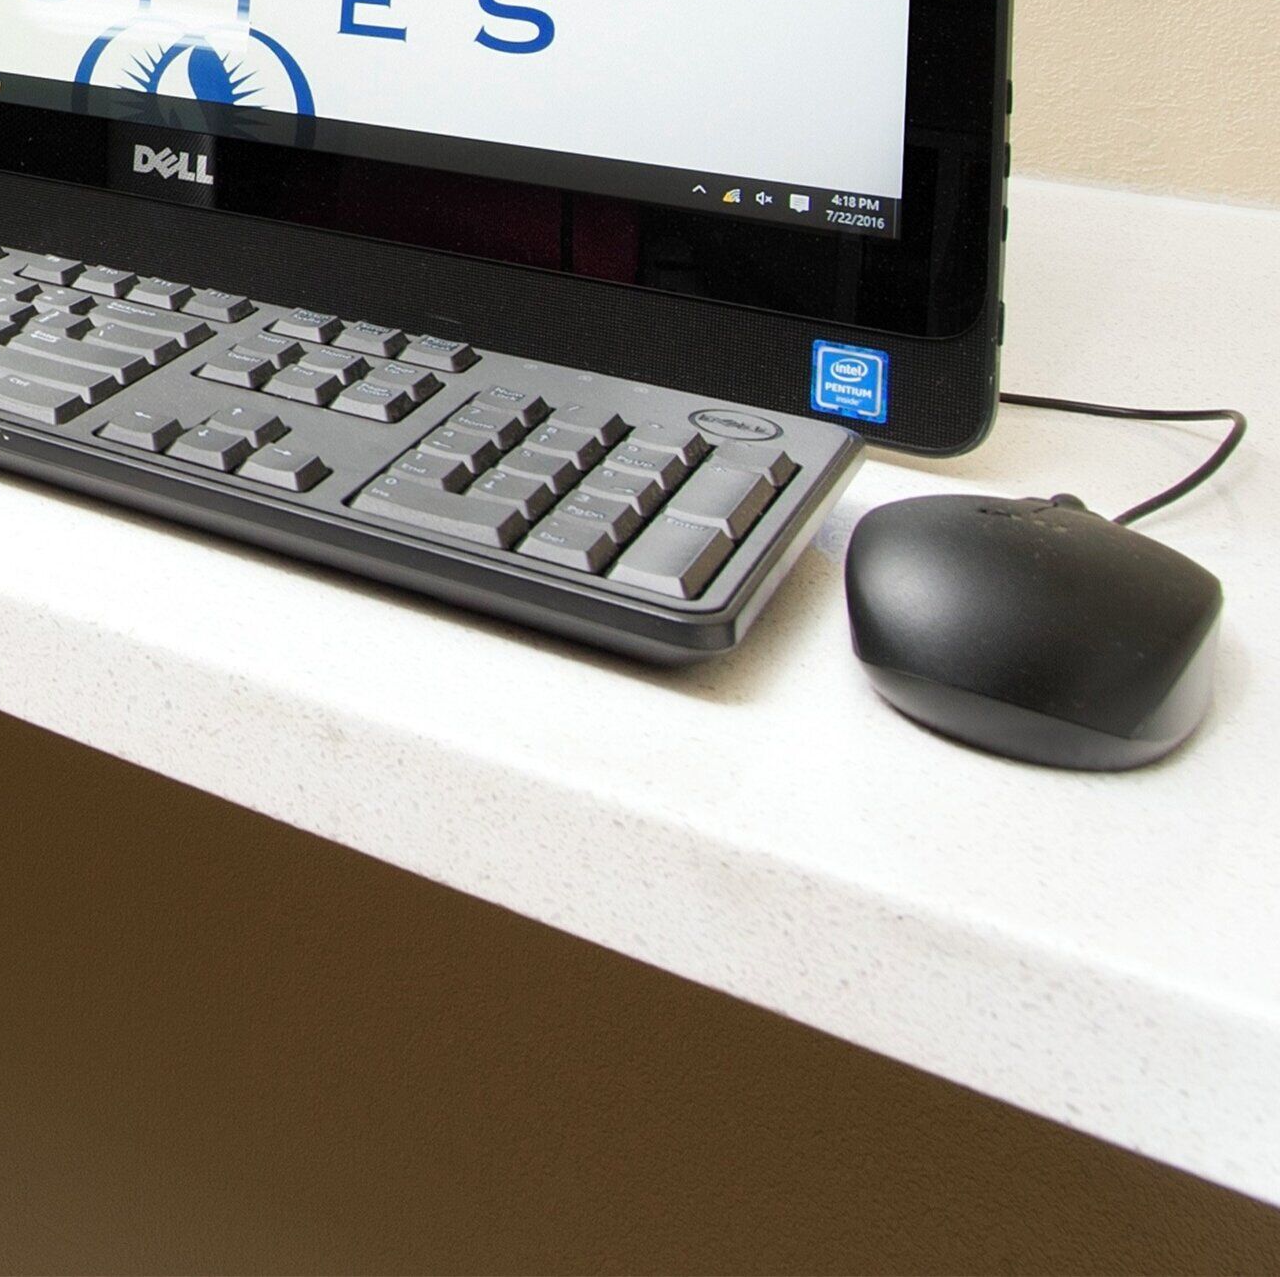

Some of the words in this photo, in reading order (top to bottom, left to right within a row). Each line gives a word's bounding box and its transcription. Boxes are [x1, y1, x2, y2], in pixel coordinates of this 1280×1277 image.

[133, 143, 214, 185] DELL
[831, 193, 856, 208] 4:18
[858, 197, 880, 212] PM
[826, 209, 885, 230] 7/22/2016
[825, 382, 873, 398] PENTIUM
